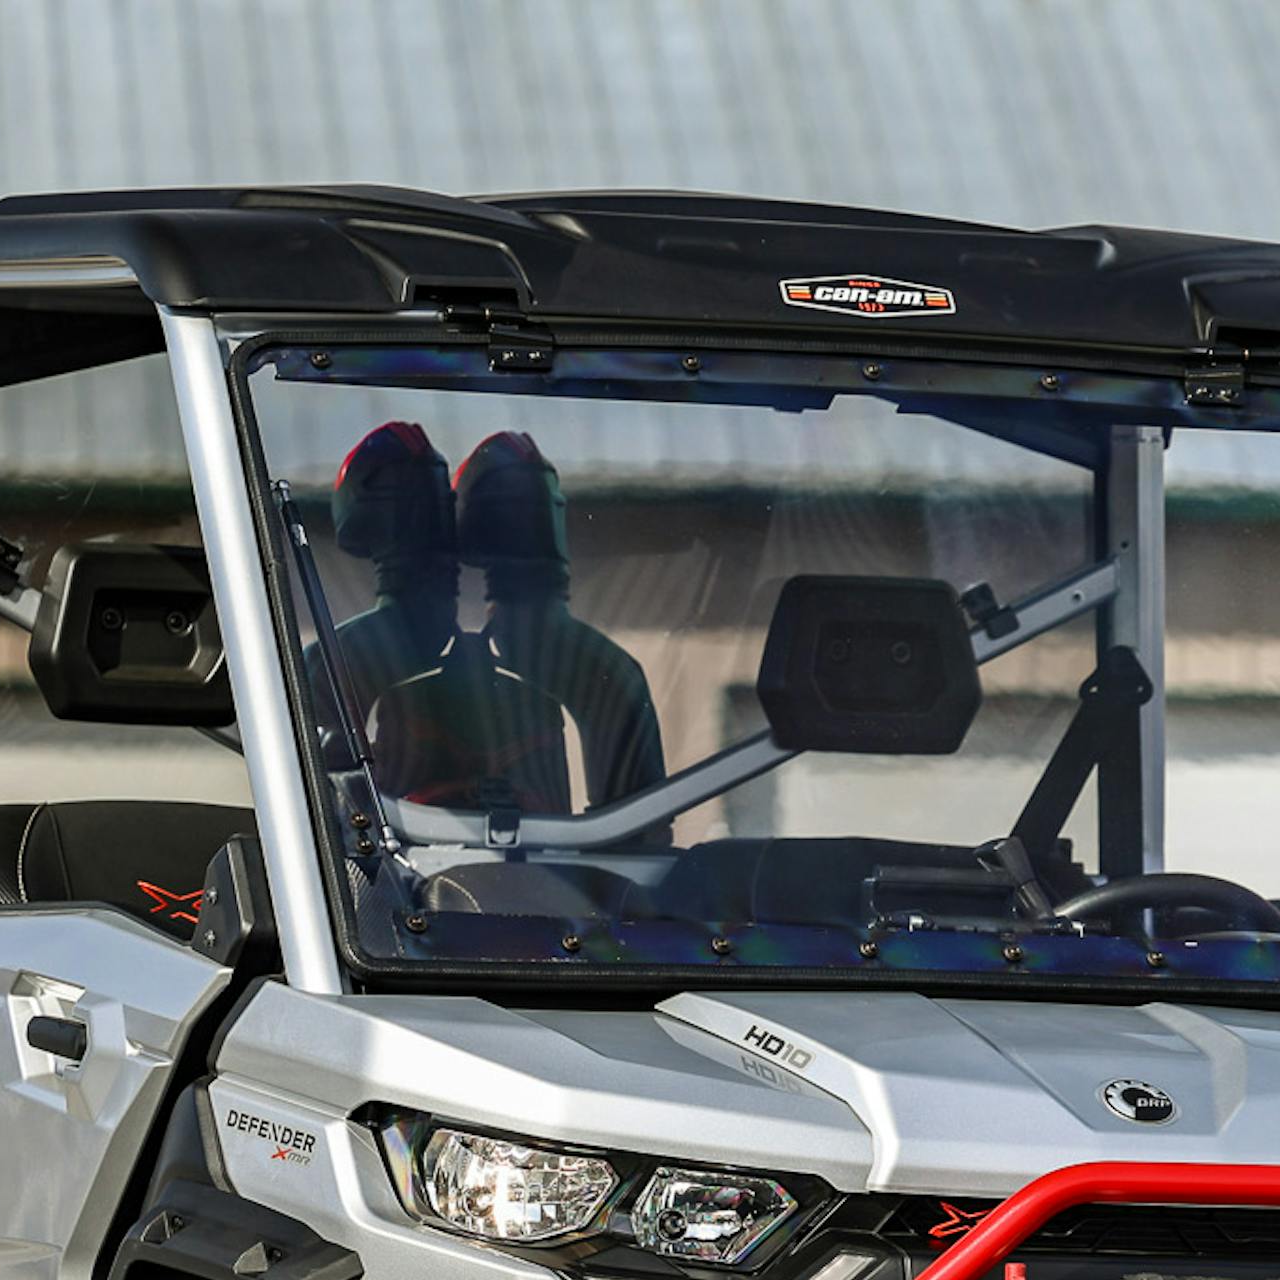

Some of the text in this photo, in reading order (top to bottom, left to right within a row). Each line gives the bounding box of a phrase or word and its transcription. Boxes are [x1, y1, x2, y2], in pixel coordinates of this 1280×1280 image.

[814, 286, 923, 307] can-am
[744, 1025, 814, 1069] HD10
[227, 1109, 317, 1153] DEFENDER
